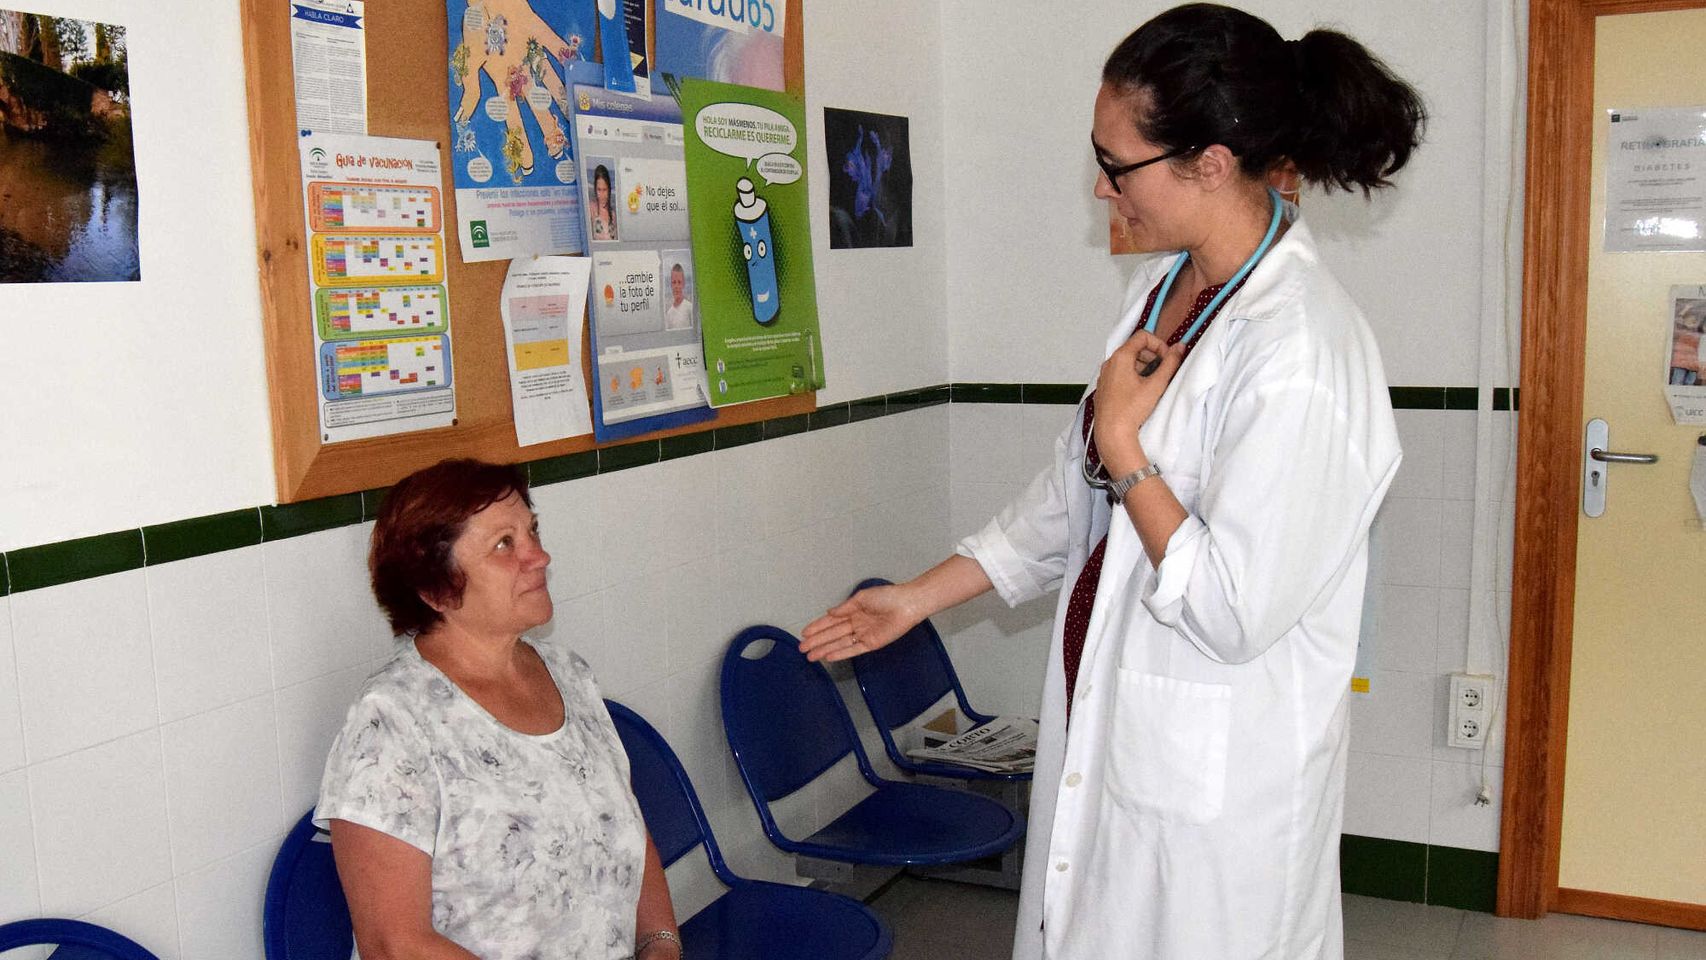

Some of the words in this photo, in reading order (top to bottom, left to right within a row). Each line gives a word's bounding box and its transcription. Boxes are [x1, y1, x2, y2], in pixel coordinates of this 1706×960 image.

[305, 11, 322, 20] HABLA
[323, 13, 344, 23] CLARO
[703, 115, 718, 124] HOLA
[719, 117, 727, 125] SOY
[703, 126, 747, 141] RECICLARME
[747, 131, 755, 142] ES
[357, 154, 366, 167] de
[1633, 163, 1691, 172] DIABETES
[646, 185, 656, 196] No
[657, 186, 676, 199] dejes
[646, 202, 660, 212] que
[661, 200, 667, 211] el
[619, 286, 626, 297] la
[628, 286, 644, 297] foto
[645, 286, 654, 297] de
[620, 301, 628, 312] tu
[631, 298, 650, 314] perfil
